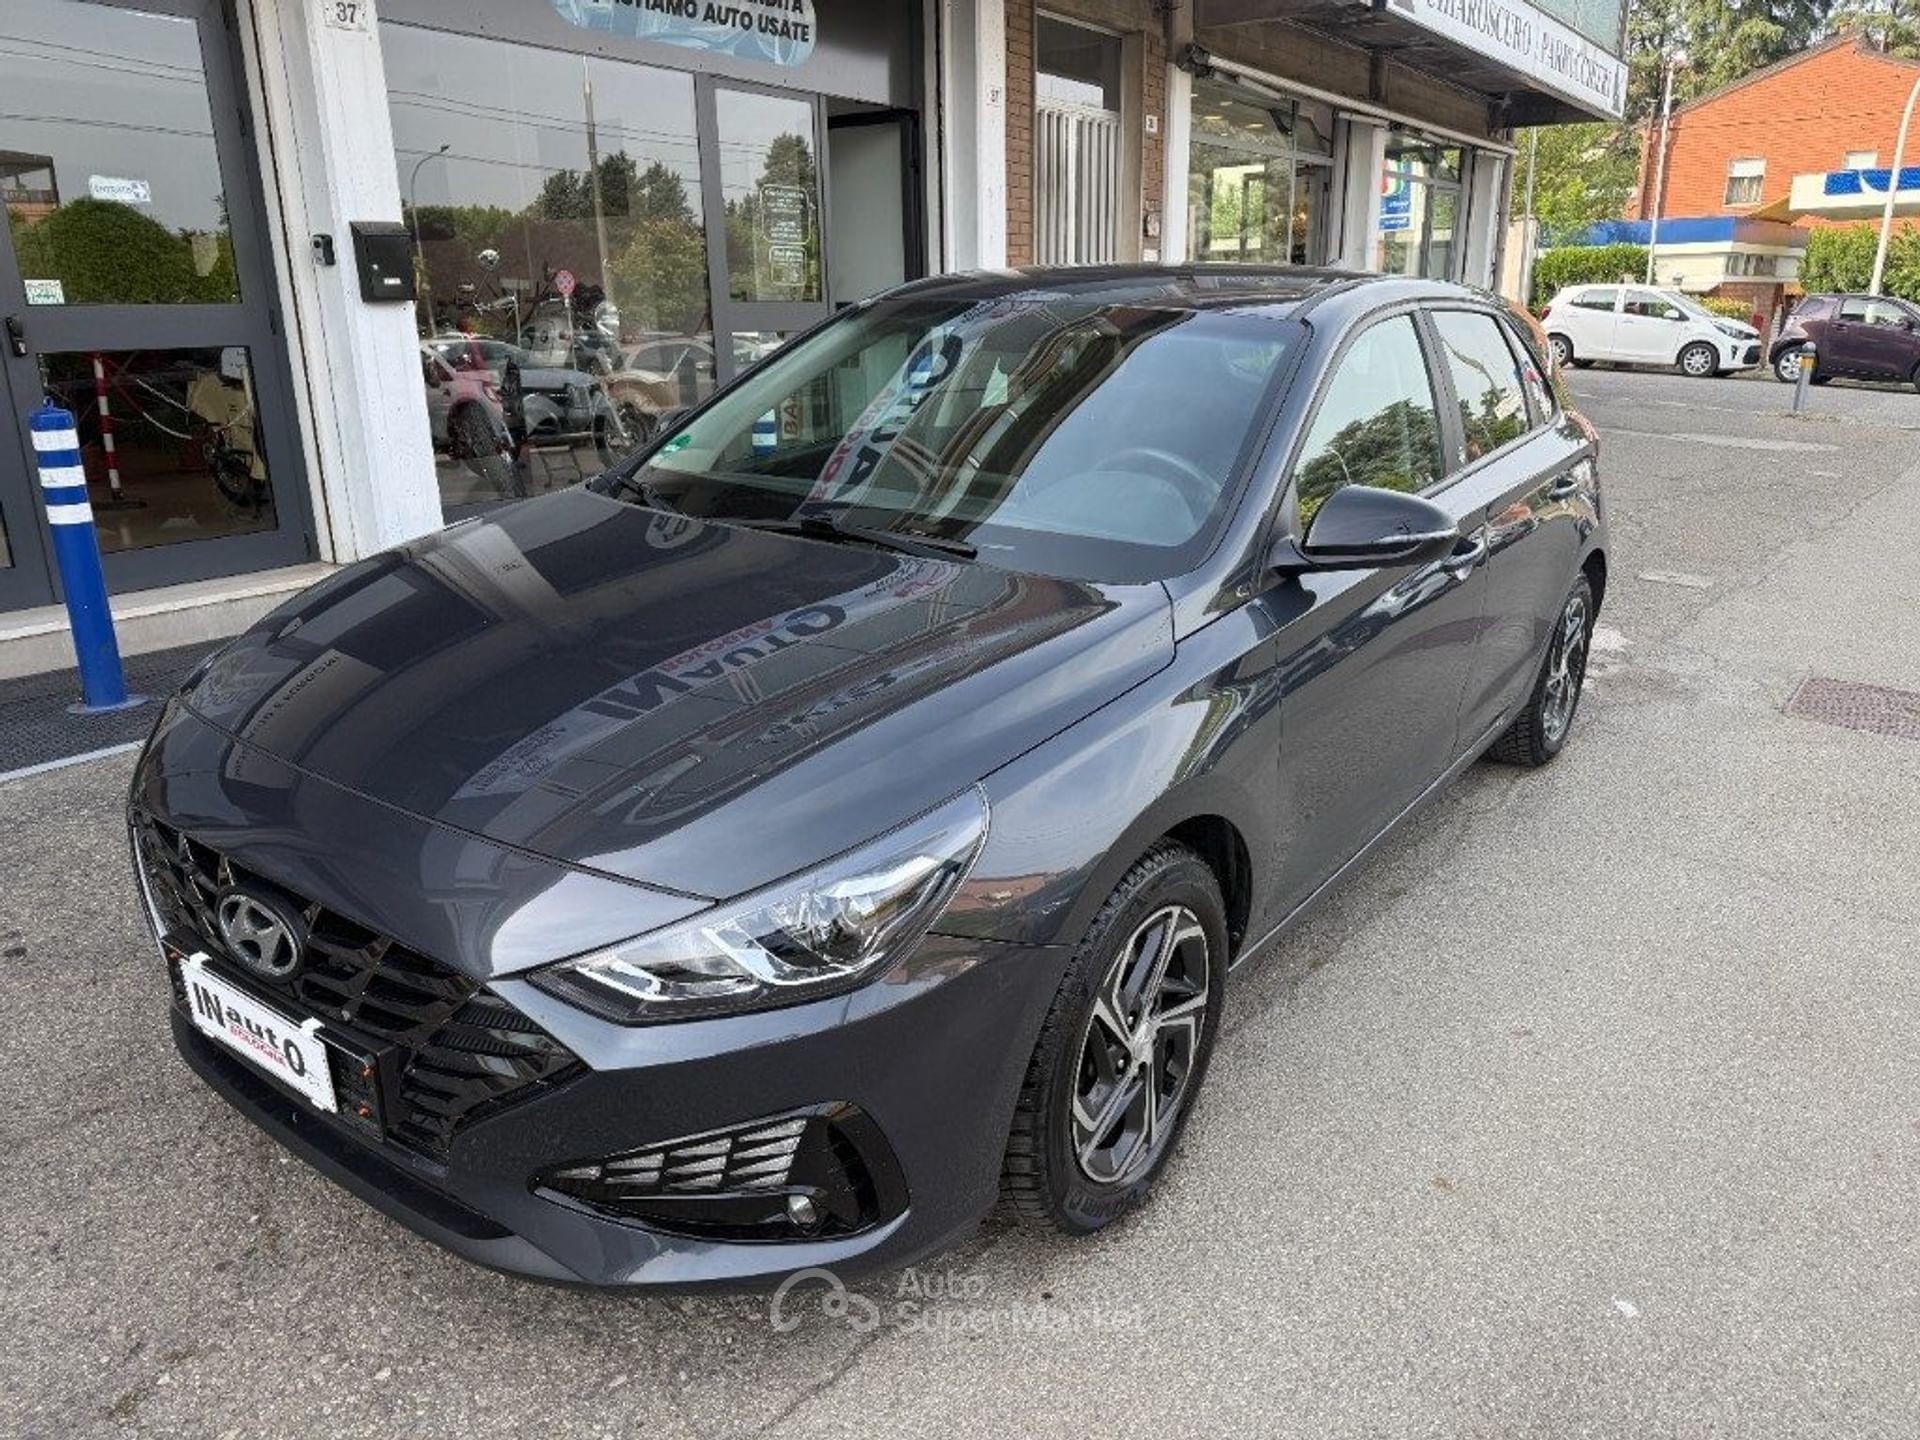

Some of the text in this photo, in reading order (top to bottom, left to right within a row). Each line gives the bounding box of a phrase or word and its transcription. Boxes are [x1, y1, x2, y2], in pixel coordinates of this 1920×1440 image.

[336, 2, 356, 23] 37
[702, 5, 752, 31] AUTO
[757, 13, 809, 42] USATE
